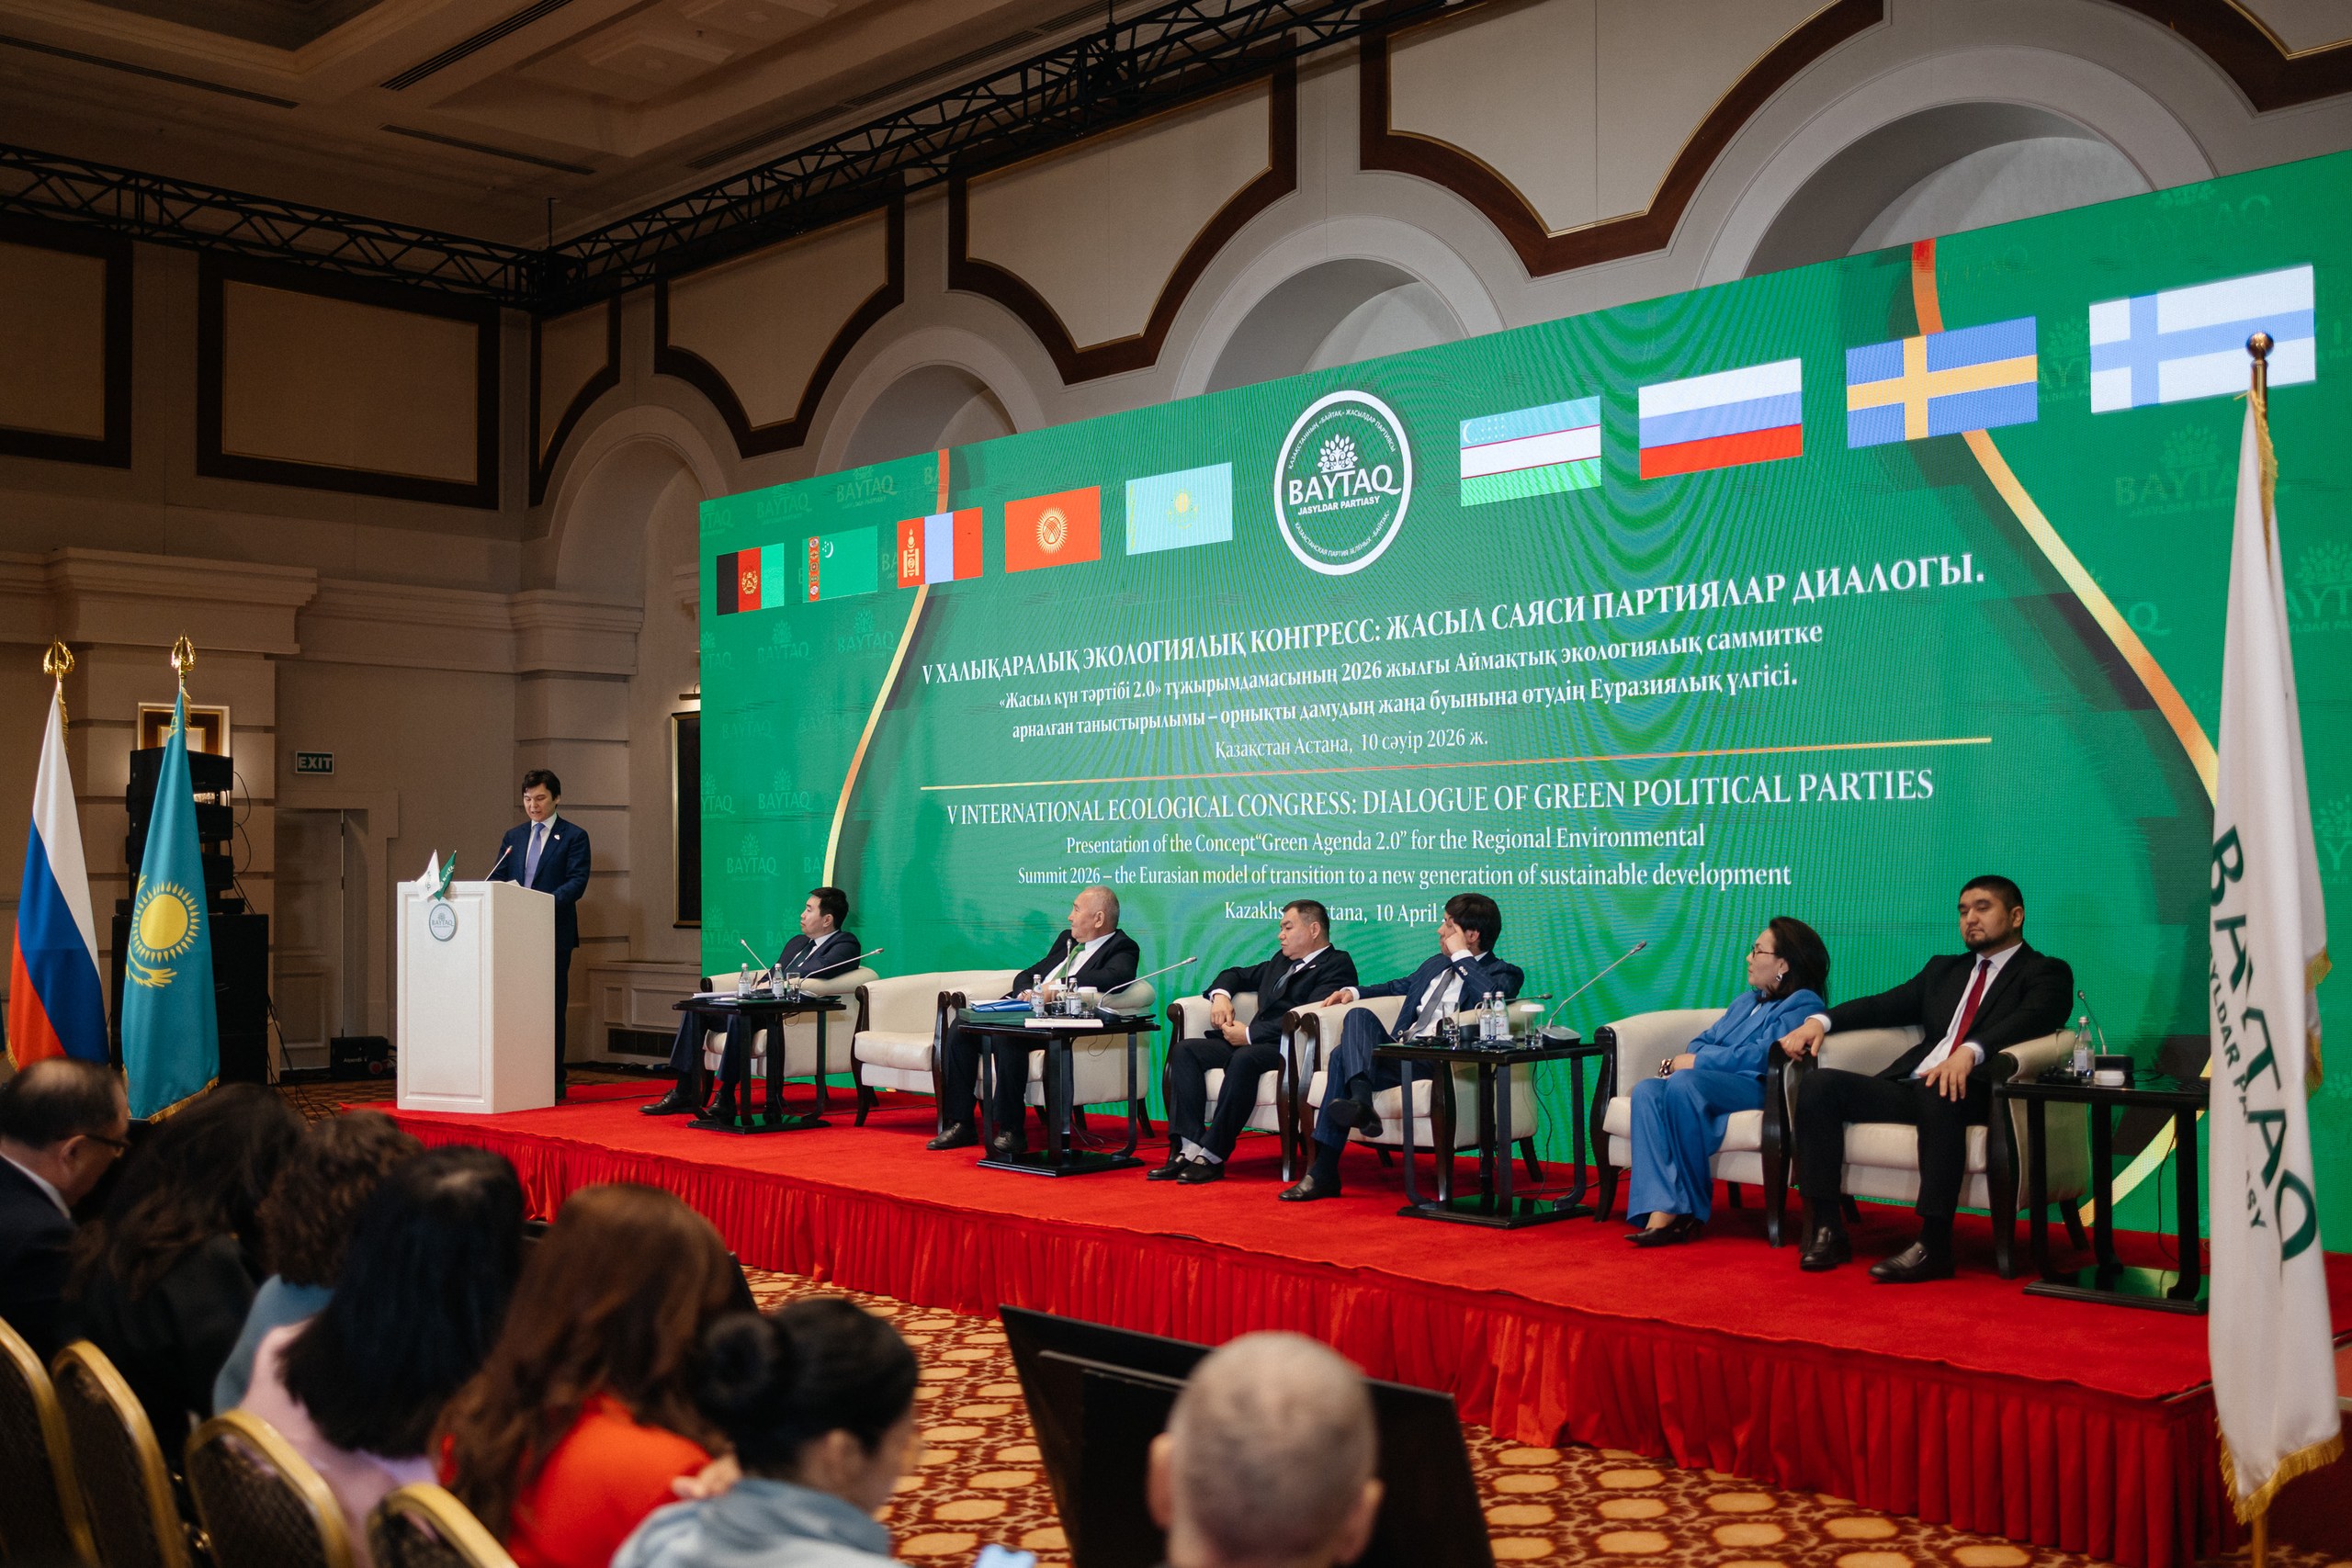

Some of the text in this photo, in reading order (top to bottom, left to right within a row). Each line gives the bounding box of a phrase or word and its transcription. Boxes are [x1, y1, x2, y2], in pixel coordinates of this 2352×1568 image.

[1289, 464, 1402, 505] BAYTAQ
[1297, 495, 1381, 515] JASYLDAR PARTIASY
[922, 552, 1984, 684] V ХАЛЫҚАРАЛЫҚ ЭКОЛОГИЯЛЫҚ КОНГРЕСС: ЖАСЫЛ САЯСИ ПАРТИЯЛАР ДИАЛОГЫ.
[999, 692, 1052, 709] «Жасыл
[1054, 691, 1078, 709] күн
[1080, 681, 1130, 706] тәртібі
[1133, 680, 1162, 698] 2.0»
[1341, 660, 1383, 682] 2026
[1385, 659, 1450, 678] жылғы
[1454, 649, 1558, 672] Аймақтық
[1561, 636, 1703, 664] экологиялық
[1706, 625, 1823, 651] саммитке
[1012, 721, 1074, 742] арналған
[1076, 712, 1205, 735] таныстырылымы
[1220, 705, 1296, 728] орнықты
[1299, 700, 1375, 722] дамудың
[1378, 696, 1426, 715] жаңа
[1430, 689, 1518, 716] буынына
[1521, 679, 1586, 708] өтудің
[1590, 674, 1724, 705] Еуразиялық
[1725, 661, 1798, 696] үлгісі.
[1216, 728, 1488, 761] Қазақстан Астана, 10 сәуір 2026 ж.
[298, 756, 333, 769] EXIT
[947, 769, 1934, 825] V INTERNATIONAL ECOLOGICAL CONGRESS: DIALOGUE OF GREEN POLITICAL PARTIES
[1067, 835, 1150, 853] Presentation
[1152, 834, 1168, 852] of
[1170, 833, 1193, 852] the
[1312, 829, 1372, 856] Agenda
[1375, 829, 1408, 851] 2.0”
[1411, 829, 1436, 850] for
[1440, 828, 1467, 850] the
[1472, 826, 1552, 855] Regional
[1556, 822, 1705, 848] Environmental
[1018, 866, 1068, 884] Summit
[1069, 867, 1101, 884] 2026
[1114, 865, 1136, 884] the
[1139, 865, 1199, 885] Eurasian
[1203, 863, 1248, 884] model
[1250, 863, 1269, 885] of
[1270, 864, 1345, 885] transition
[1349, 868, 1365, 885] to
[1368, 870, 1378, 885] a
[1382, 870, 1416, 885] new
[1419, 864, 1513, 890] generation
[1518, 863, 1539, 886] of
[1540, 862, 1648, 886] sustainable
[1652, 861, 1792, 892] development
[1225, 900, 1284, 919] Kazakhs
[1326, 905, 1367, 924] tana,
[1376, 903, 1394, 921] 10
[1396, 902, 1438, 928] April
